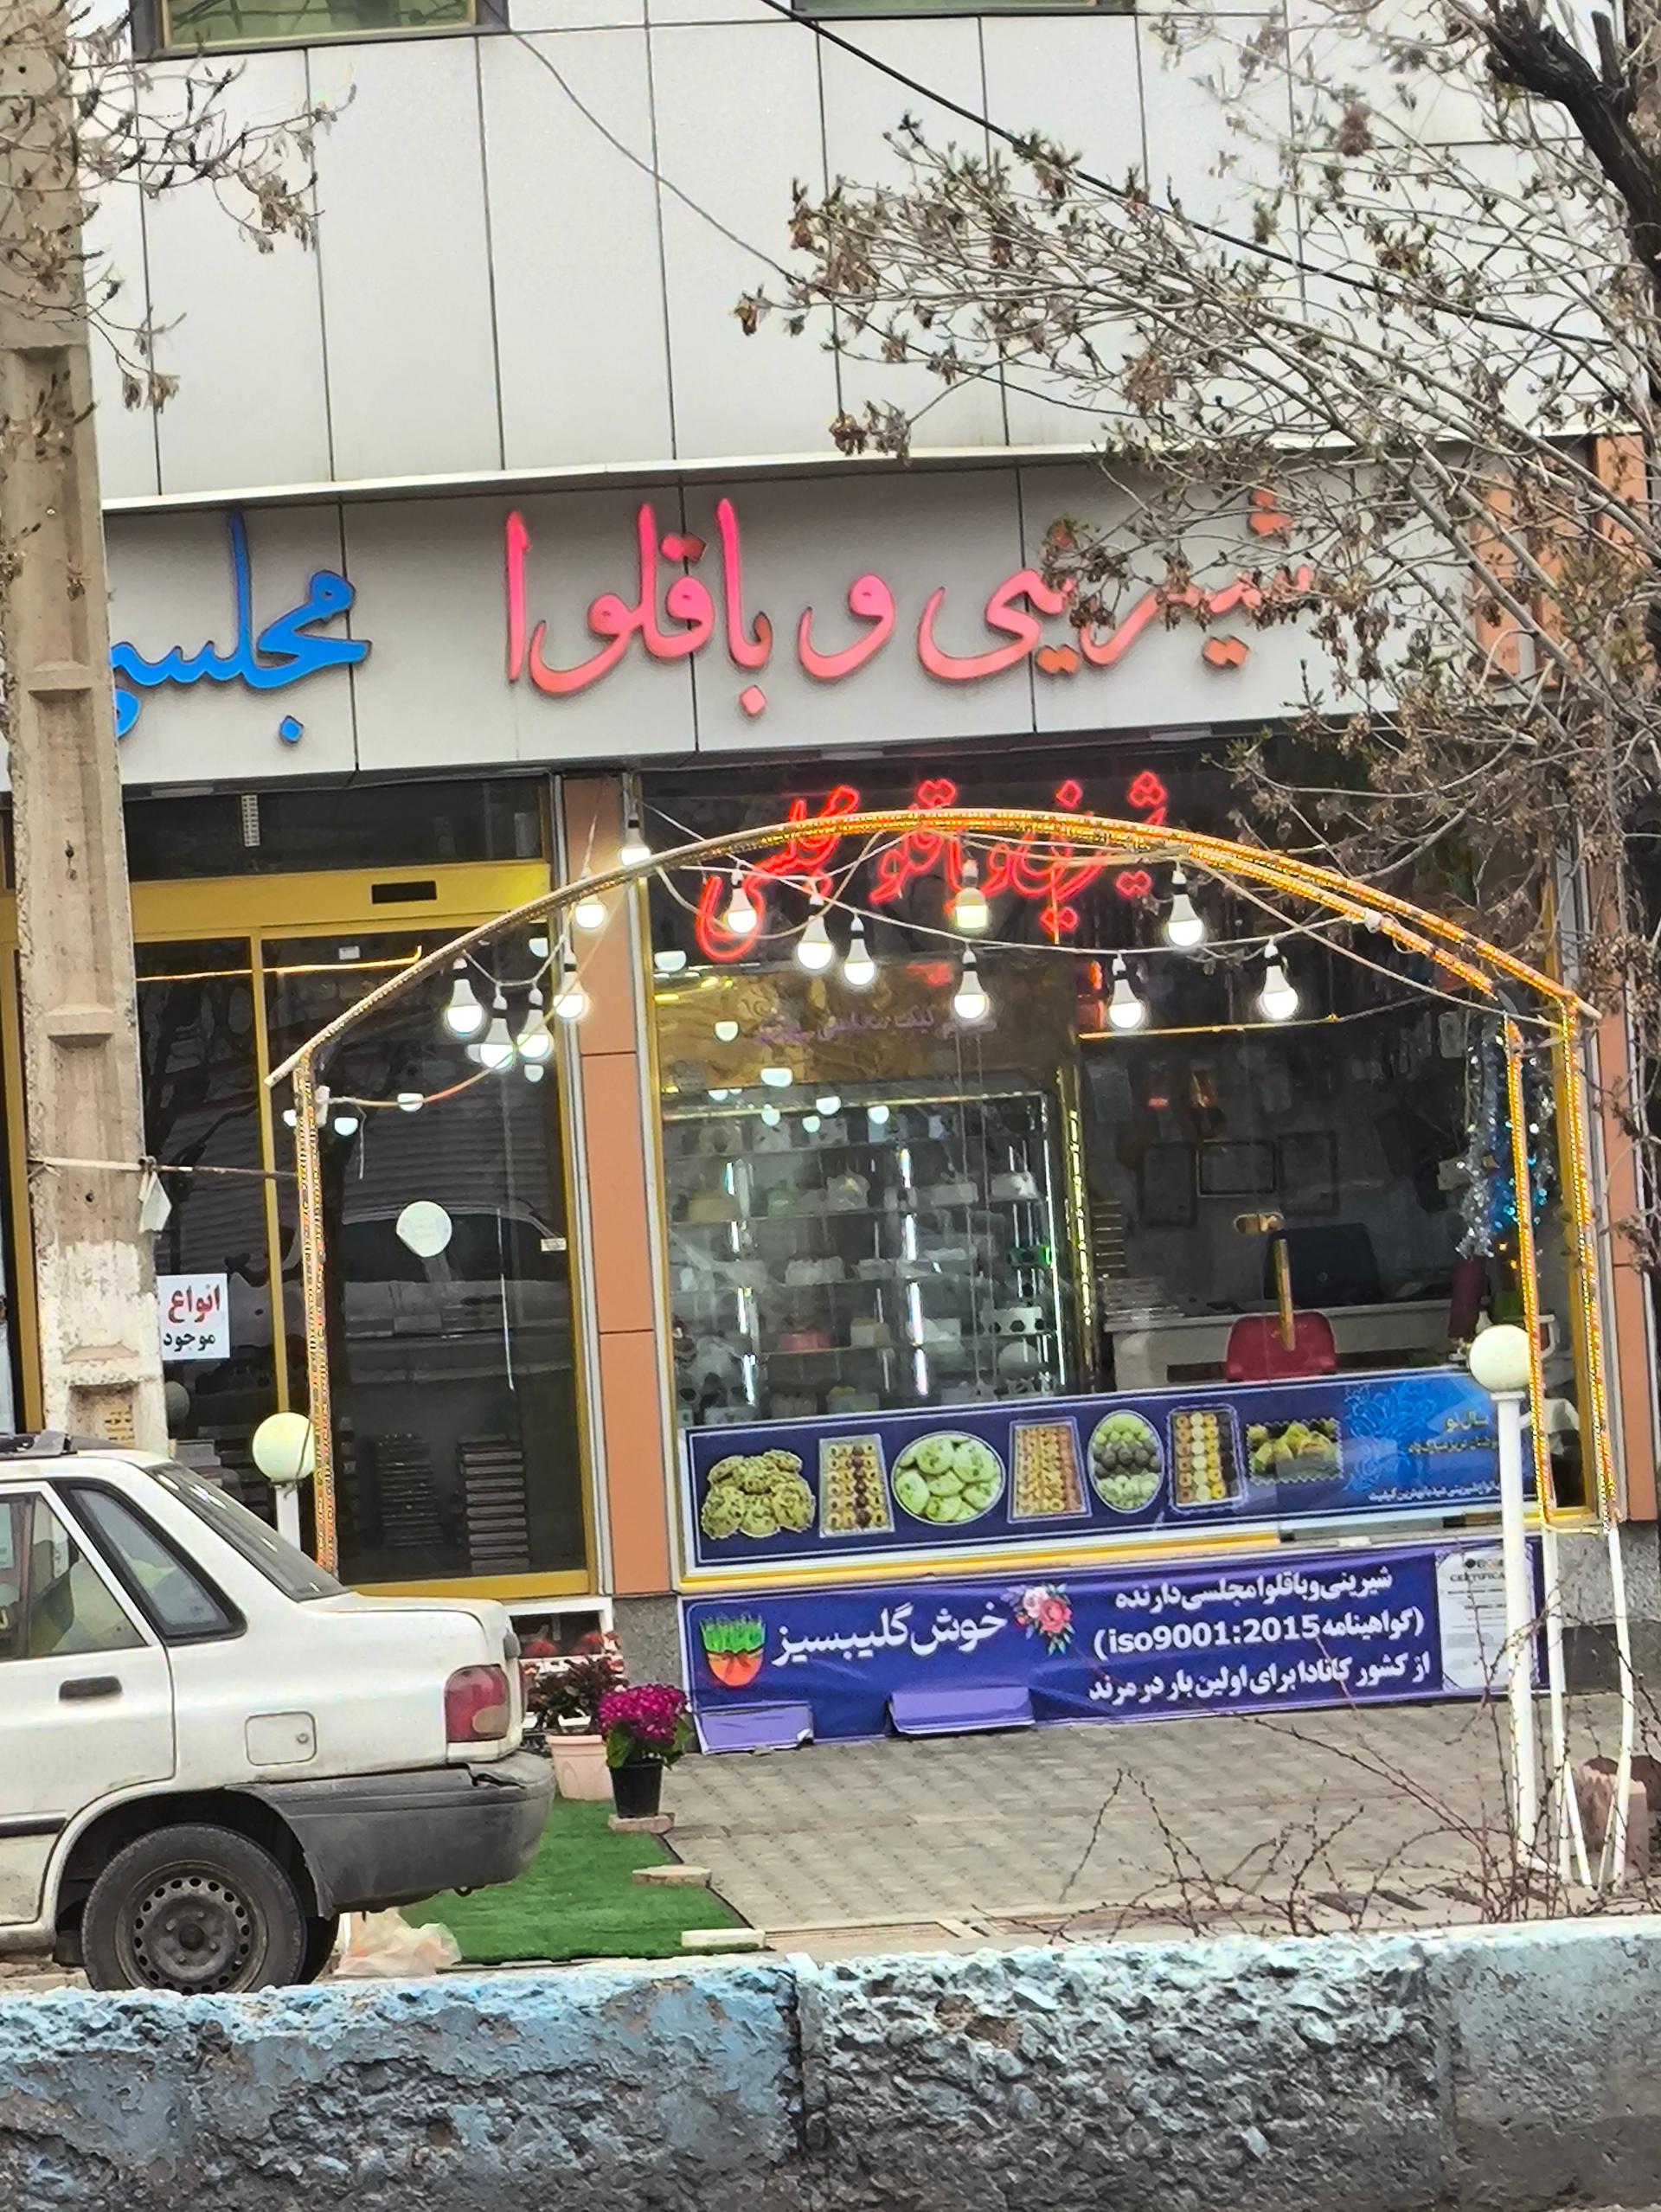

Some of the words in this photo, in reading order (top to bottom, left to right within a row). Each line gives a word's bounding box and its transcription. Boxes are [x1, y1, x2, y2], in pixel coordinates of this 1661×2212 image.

[506, 497, 773, 718] باقلوا
[798, 572, 896, 682] و
[168, 1285, 221, 1323] انواع
[163, 1332, 216, 1352] موجود
[1115, 1581, 1182, 1614] دارنده
[1181, 1577, 1256, 1611] مجلسی
[1255, 1571, 1308, 1605] باقلوا
[1320, 1566, 1394, 1600] شیرینی
[771, 1601, 914, 1667] گلیبسیز
[909, 1600, 1009, 1657] خوش
[1195, 1664, 1248, 1698] اولین
[1249, 1662, 1297, 1695] برای
[1298, 1656, 1353, 1683] کانادا
[1355, 1651, 1409, 1687] کشور
[1412, 1651, 1431, 1683] از
[1088, 1675, 1138, 1706] مرند
[1138, 1675, 1165, 1703] در
[1166, 1669, 1195, 1702] بار
